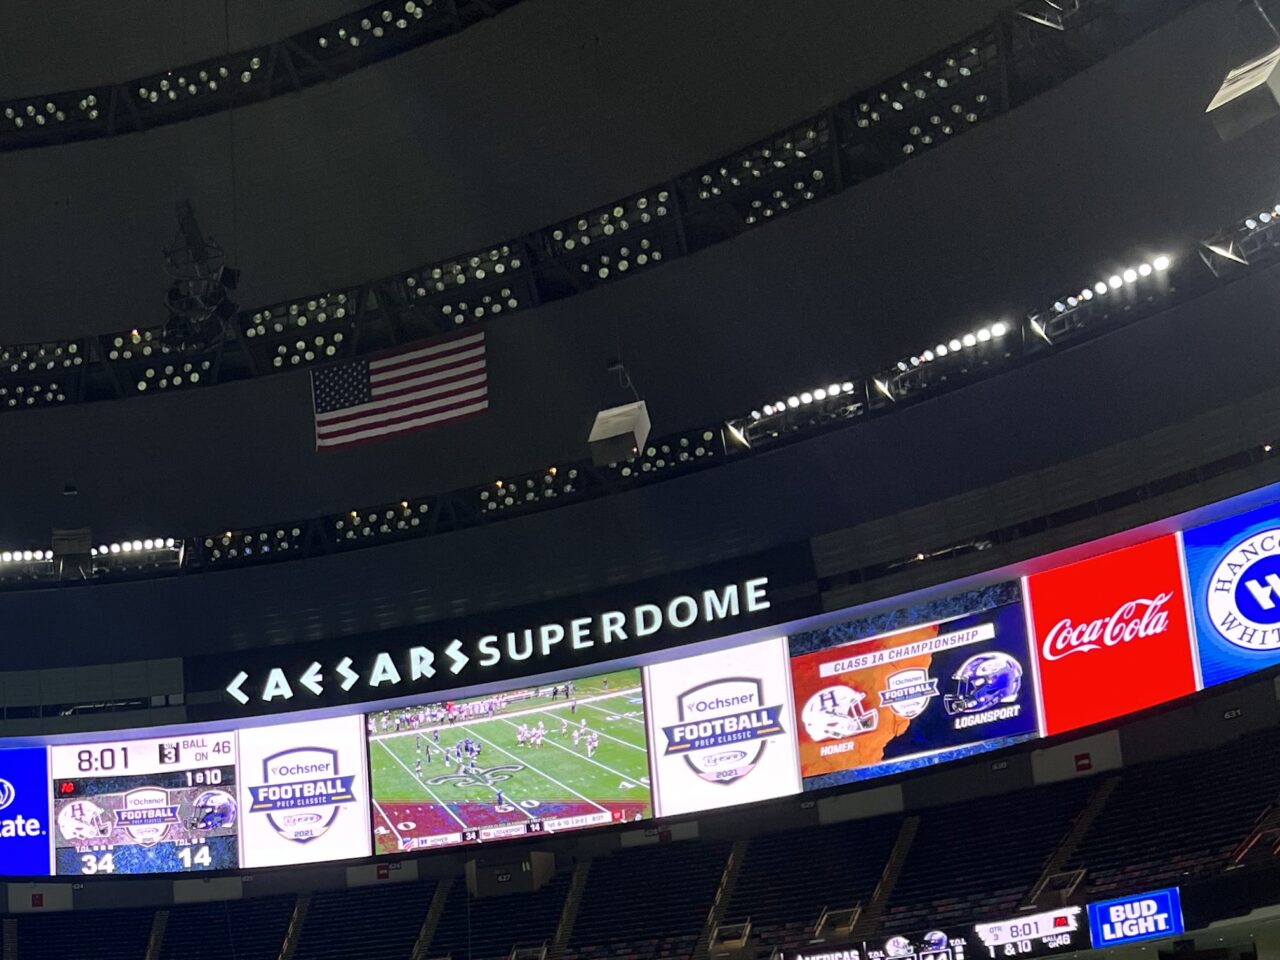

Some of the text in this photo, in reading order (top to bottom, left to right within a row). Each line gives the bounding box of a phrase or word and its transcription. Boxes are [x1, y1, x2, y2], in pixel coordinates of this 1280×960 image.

[1214, 535, 1280, 594] HANC
[1043, 591, 1174, 661] Coca-Cola
[226, 576, 772, 704] CAESARS SUPERDOME
[833, 630, 979, 673] CLASS 1A CHAMPIONSHIP
[885, 682, 932, 700] FOOTBALL
[695, 693, 755, 712] Ochsner
[954, 704, 1021, 730] LOGANSPORT
[1224, 705, 1241, 719] 631
[673, 710, 774, 742] FOOTBALL
[182, 739, 208, 750] BALL
[212, 740, 232, 754] 46
[695, 730, 752, 748] PREP CLASSIC
[163, 750, 177, 764] 3
[194, 752, 209, 763] ON
[821, 741, 855, 757] HOMER
[78, 746, 129, 772] 8:01
[186, 772, 194, 786] 1
[206, 769, 222, 785] 10
[279, 762, 331, 776] Ochsner
[715, 768, 739, 778] 2021
[258, 779, 347, 802] FOOTBALL
[276, 796, 327, 809] PREP CLASSIC
[121, 809, 174, 821] FOOTBALL
[294, 829, 314, 838] 2021
[465, 831, 476, 841] 34
[529, 823, 540, 832] 14
[81, 853, 115, 875] 34
[178, 846, 212, 868] 14
[1109, 899, 1158, 923] BUD
[1010, 921, 1040, 939] 8:01
[1102, 913, 1169, 941] LIGHT
[1056, 933, 1071, 946] 46
[988, 939, 1032, 959] 1 & 10
